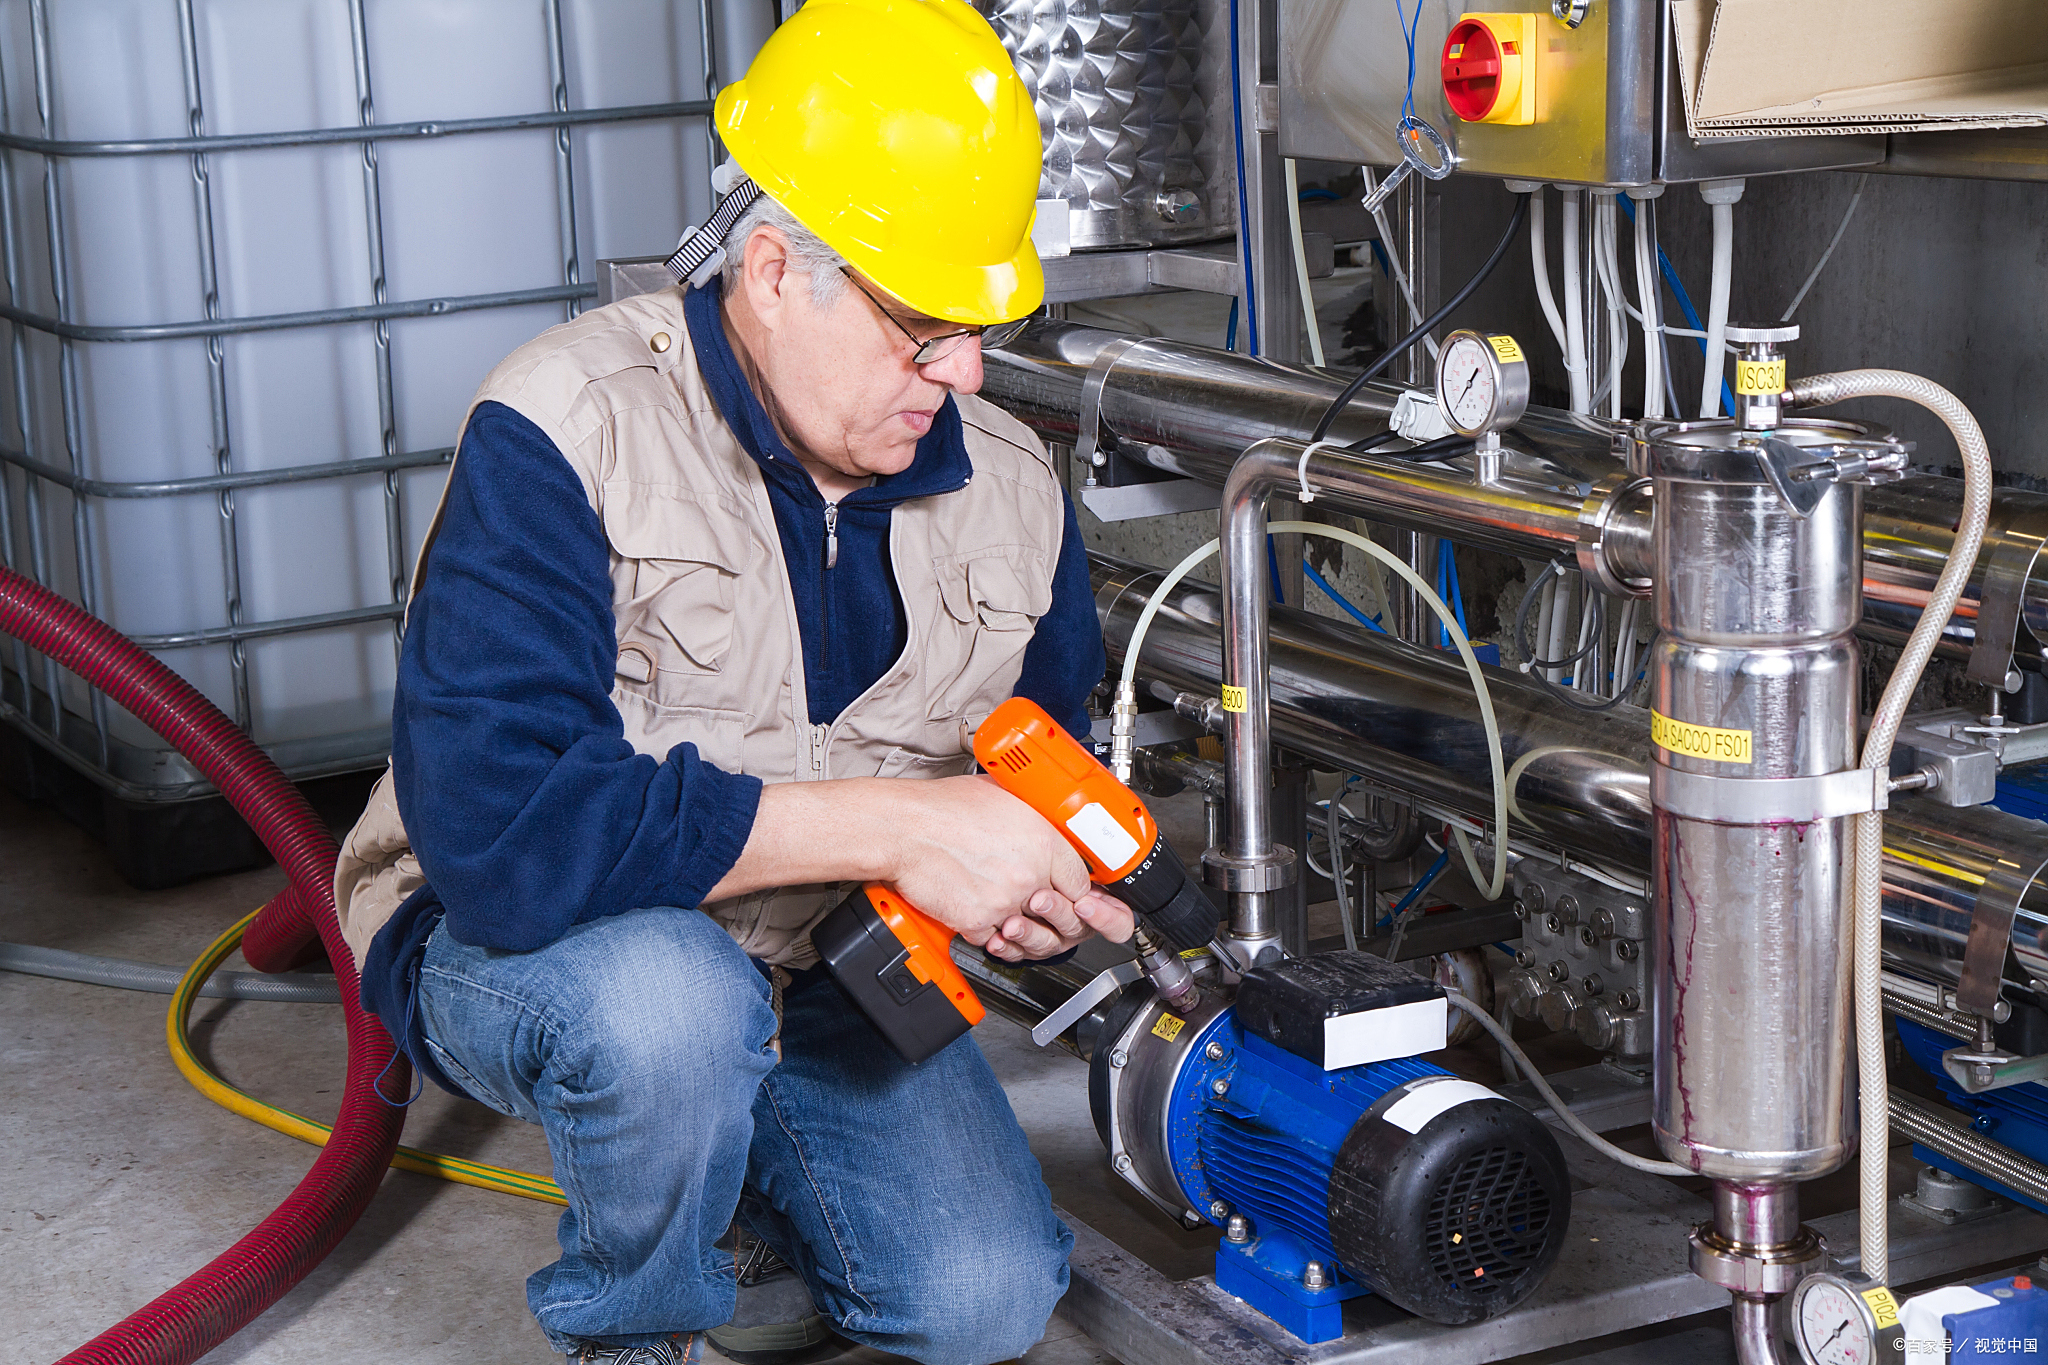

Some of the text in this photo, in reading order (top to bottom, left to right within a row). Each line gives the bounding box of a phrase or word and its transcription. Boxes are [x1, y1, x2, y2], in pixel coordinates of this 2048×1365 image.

[1738, 365, 1785, 389] VSC301
[1663, 722, 1669, 744] A
[1671, 724, 1711, 754] SACCO
[1715, 734, 1748, 757] FS01
[1142, 859, 1153, 871] 13
[1124, 875, 1136, 885] 15
[1868, 1292, 1897, 1323] PI02
